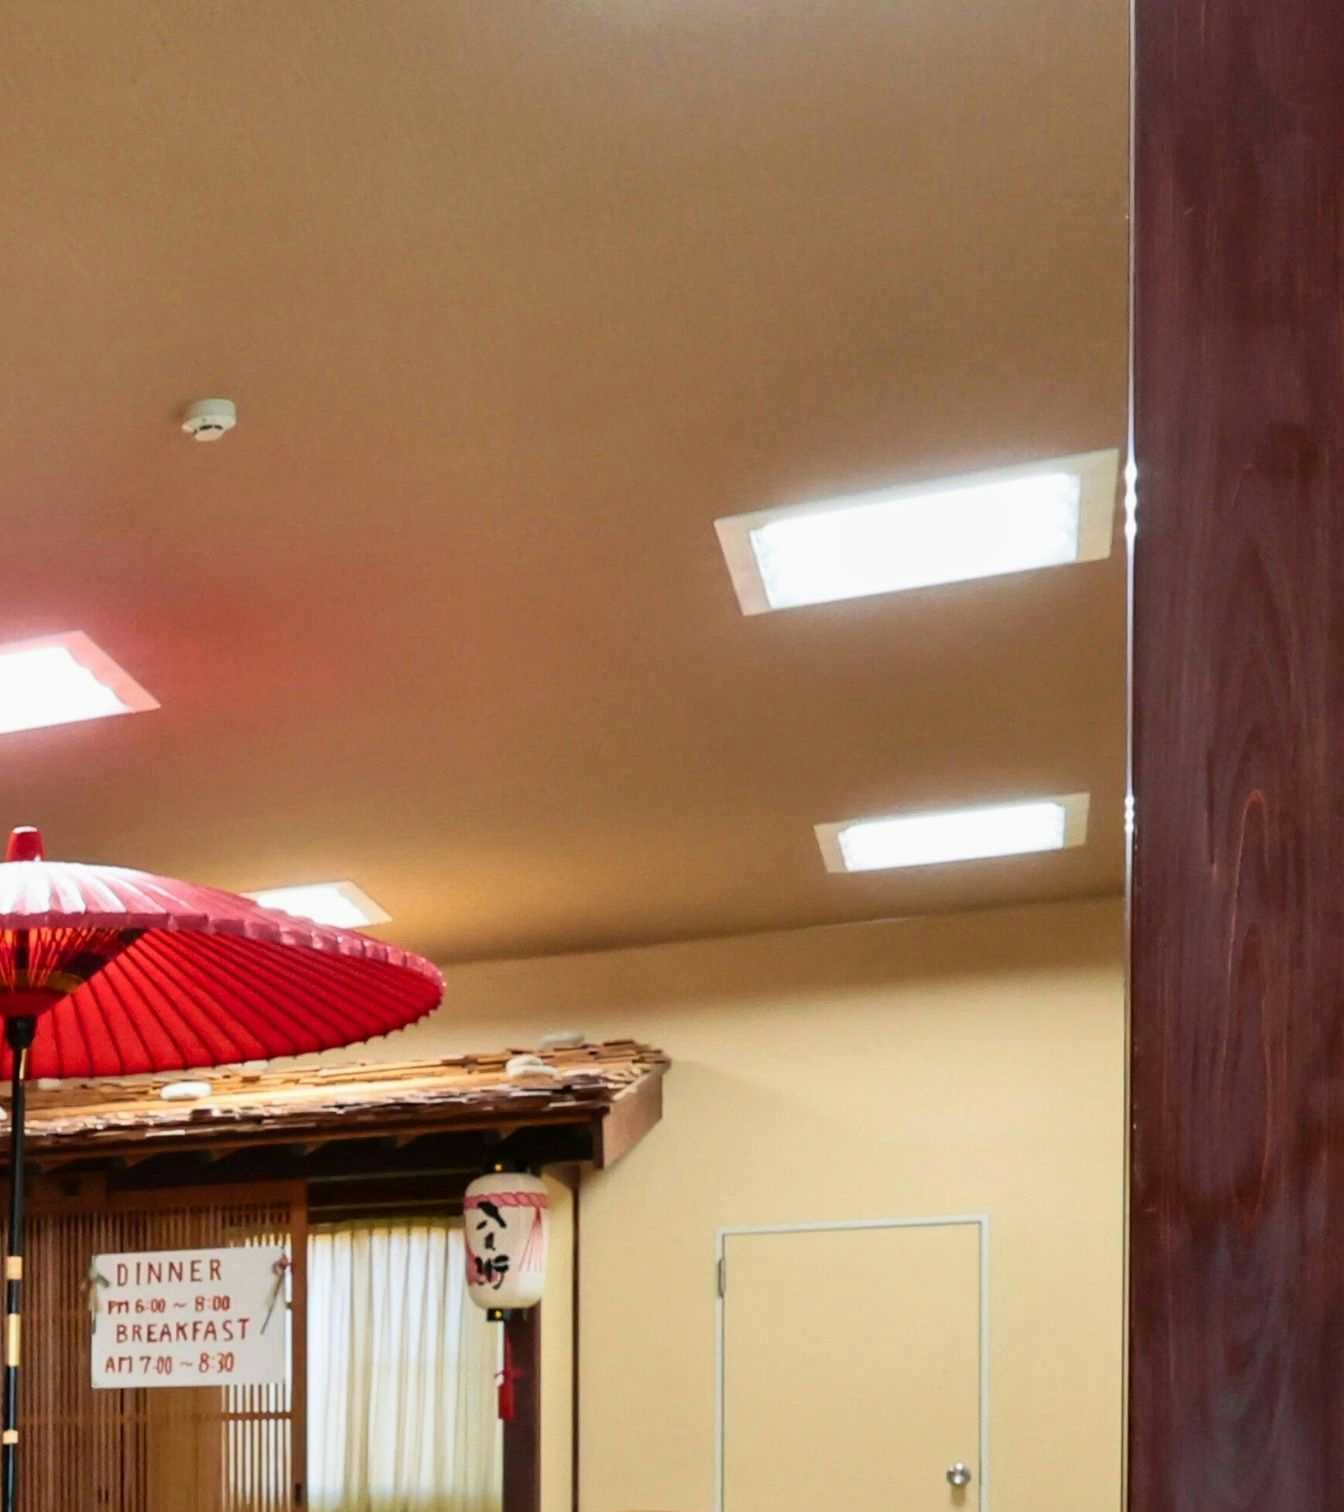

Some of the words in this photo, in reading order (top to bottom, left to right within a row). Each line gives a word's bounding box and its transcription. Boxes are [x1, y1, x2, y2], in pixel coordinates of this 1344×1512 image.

[116, 1258, 222, 1288] DINNER
[107, 1300, 129, 1315] PM
[195, 1295, 231, 1312] 8:00
[116, 1317, 250, 1344] BREAKFAST
[105, 1355, 133, 1374] AM
[199, 1351, 235, 1374] 8:30
